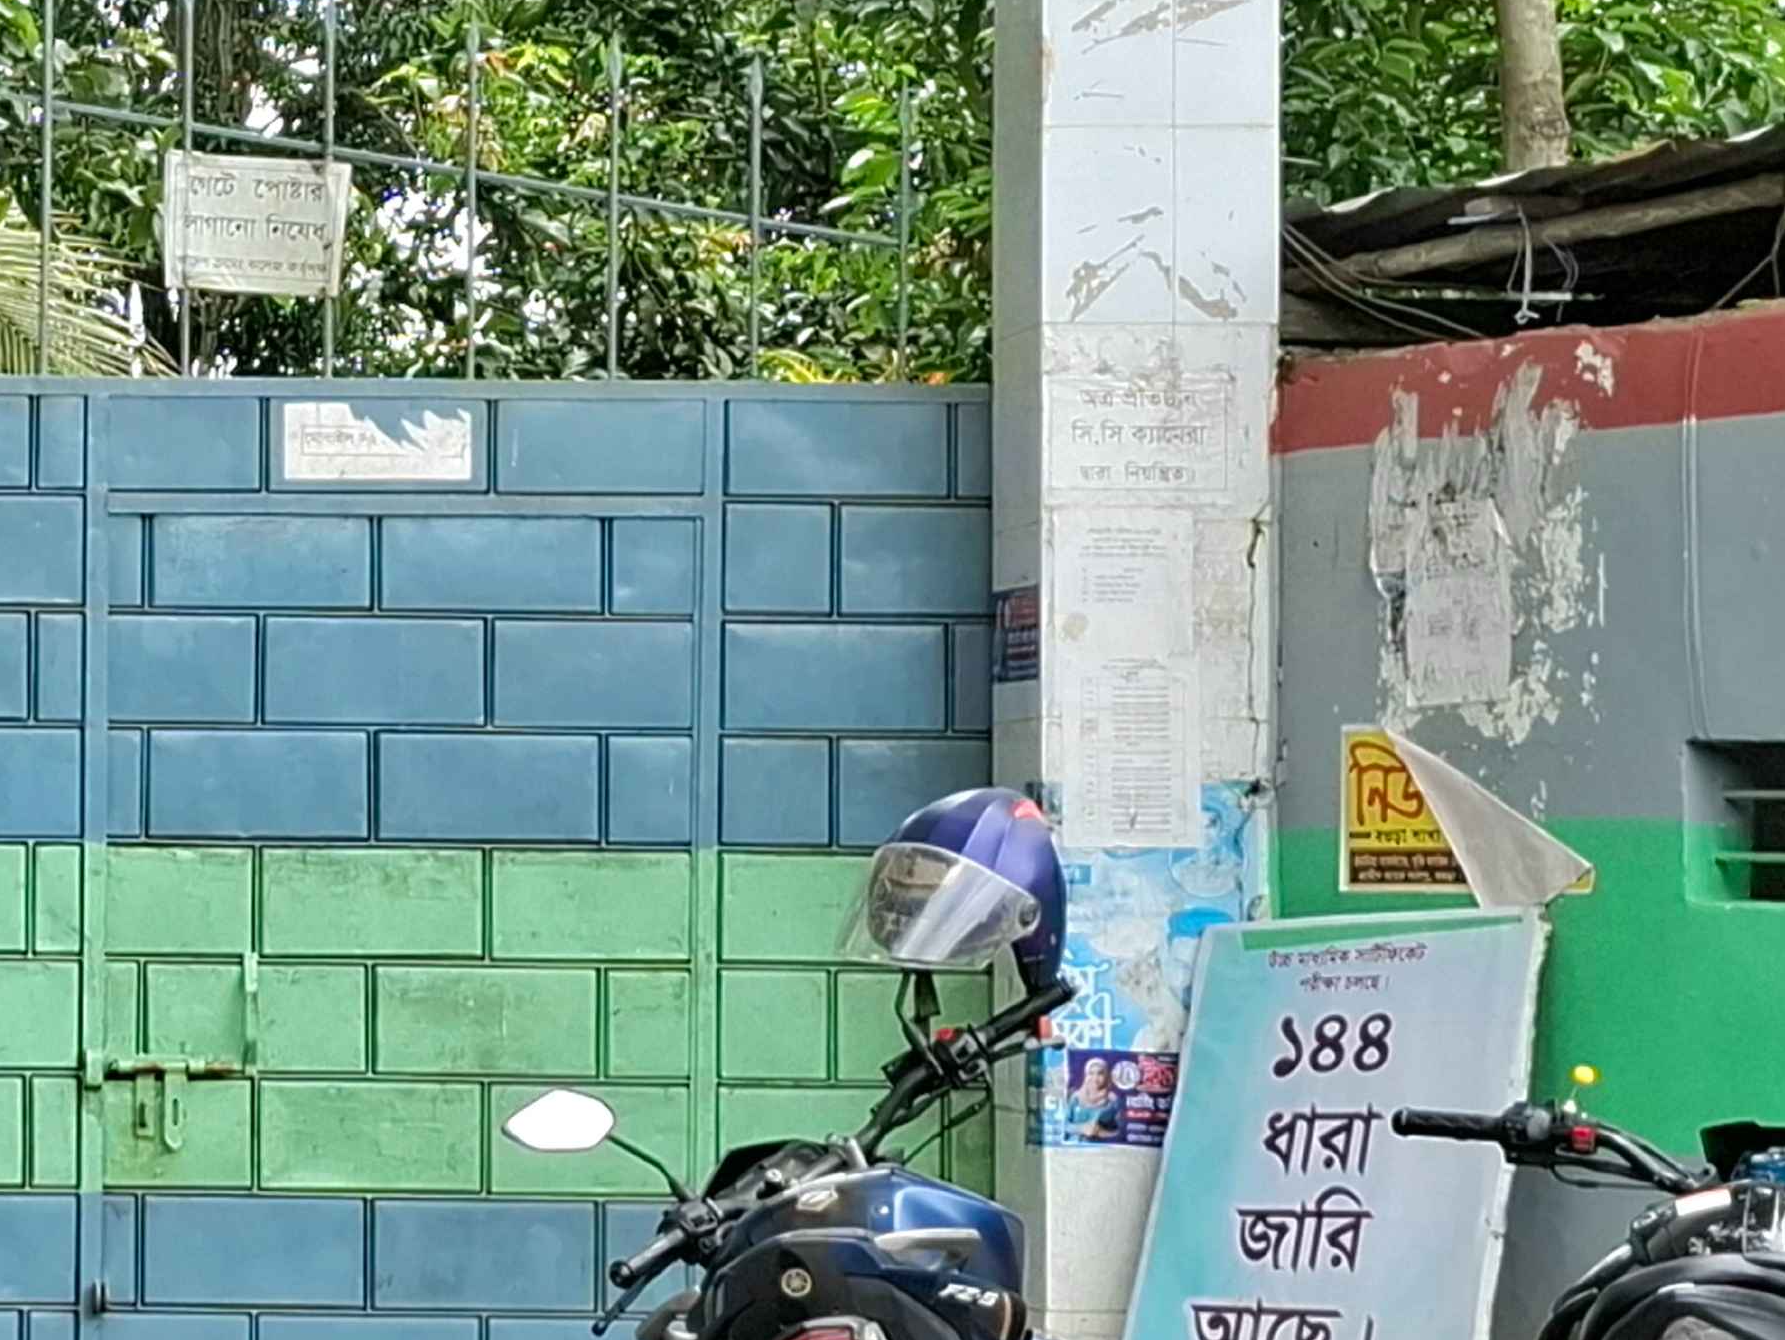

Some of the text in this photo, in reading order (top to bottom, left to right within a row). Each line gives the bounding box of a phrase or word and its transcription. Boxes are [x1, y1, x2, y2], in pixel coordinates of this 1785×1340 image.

[1270, 1010, 1394, 1079] ১৪৪
[1262, 1103, 1384, 1178] ধারা
[1236, 1186, 1375, 1273] জারি
